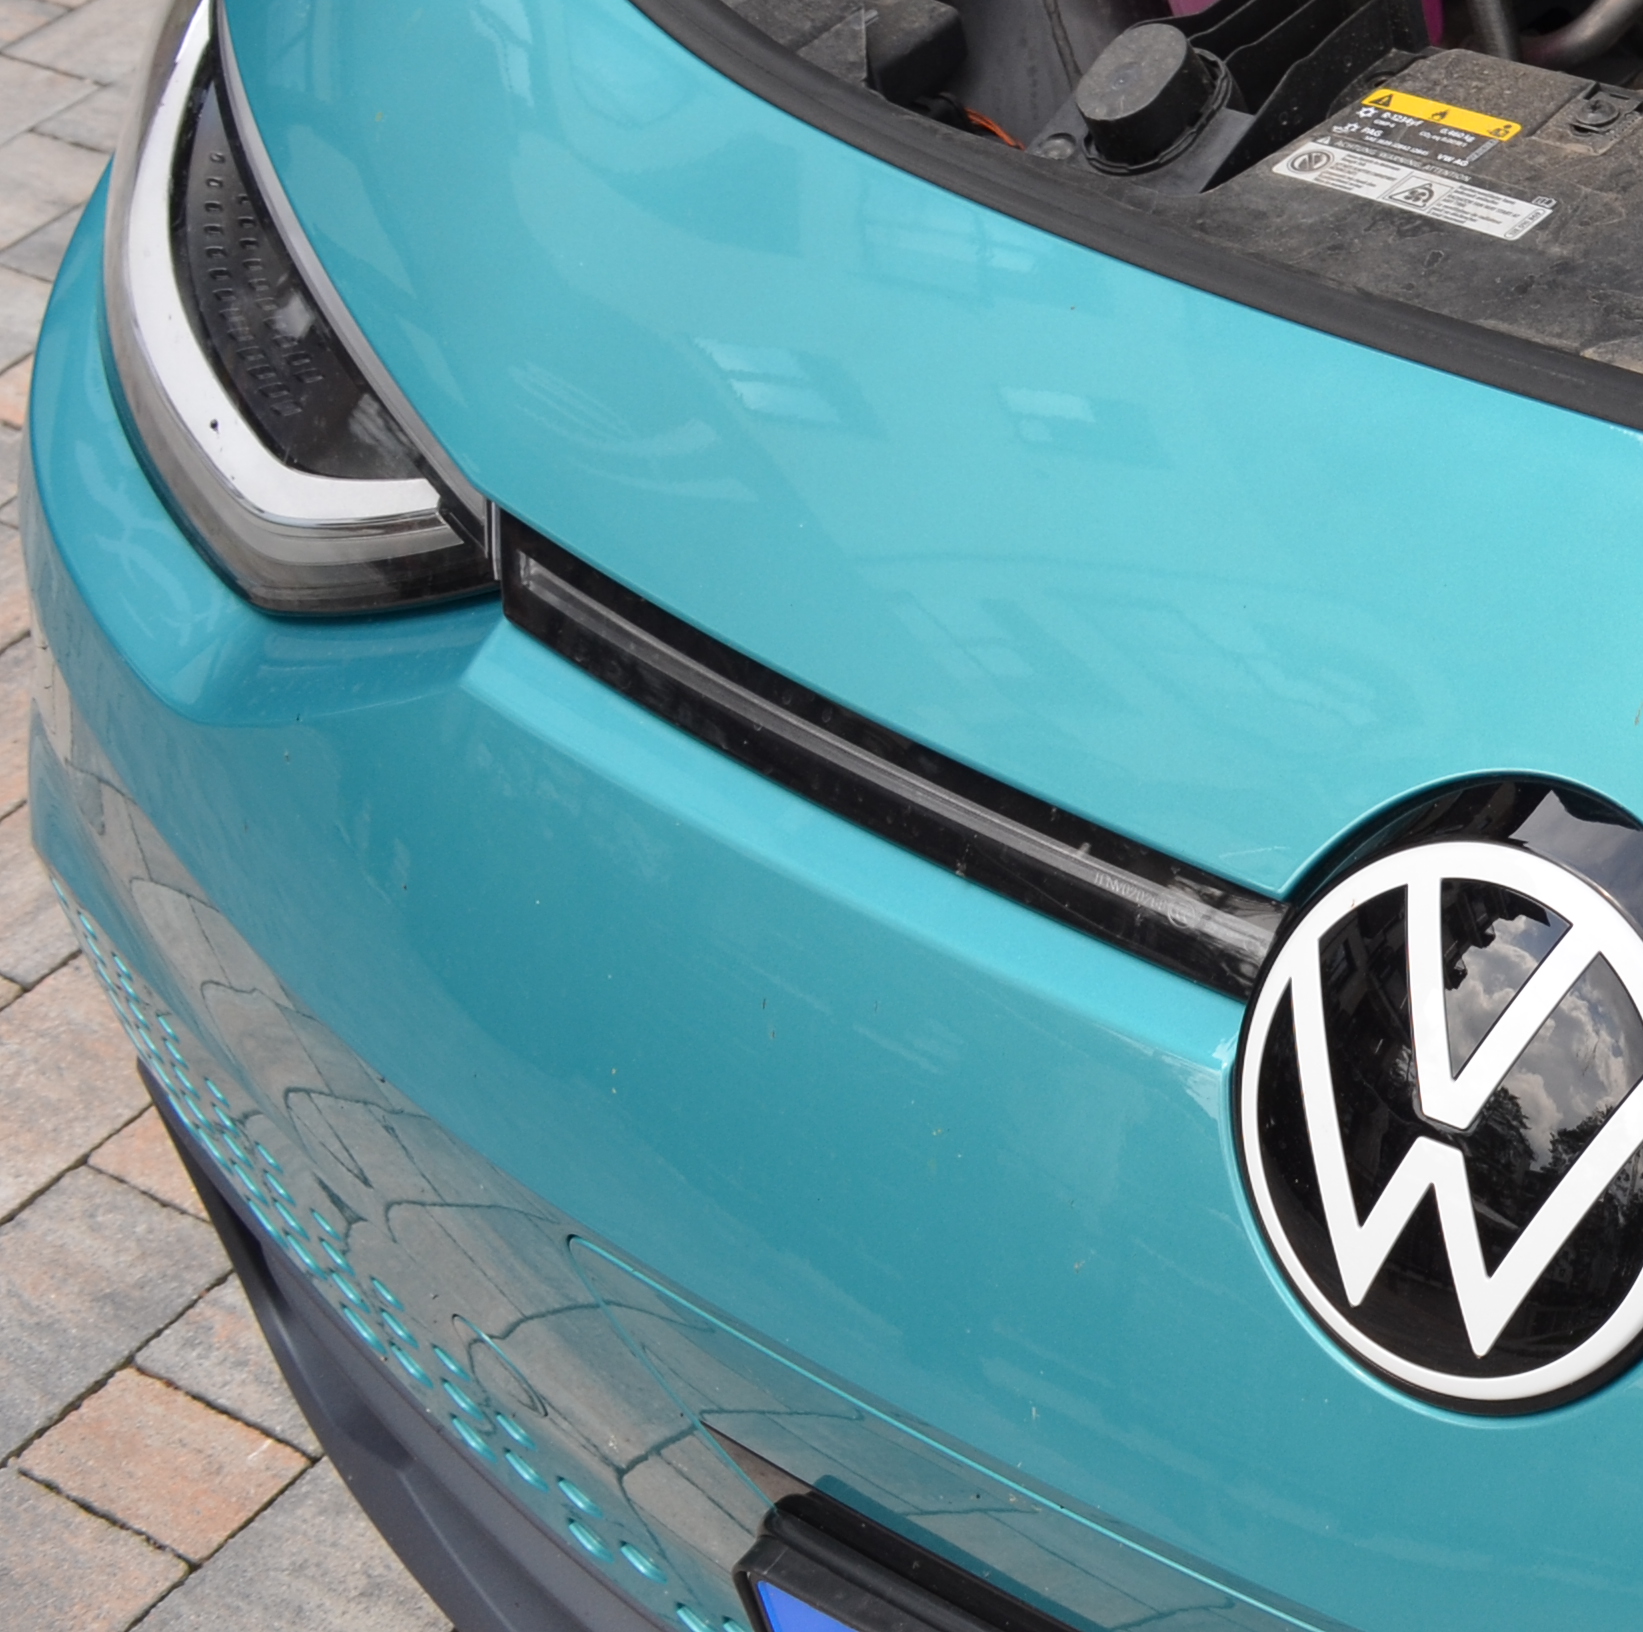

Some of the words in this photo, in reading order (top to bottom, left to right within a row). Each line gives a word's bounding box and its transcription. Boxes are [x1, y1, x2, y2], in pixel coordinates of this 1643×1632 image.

[1361, 127, 1383, 137] PAG
[1437, 153, 1455, 162] VW
[1452, 158, 1469, 167] AG
[1421, 164, 1472, 182] ATTENTION
